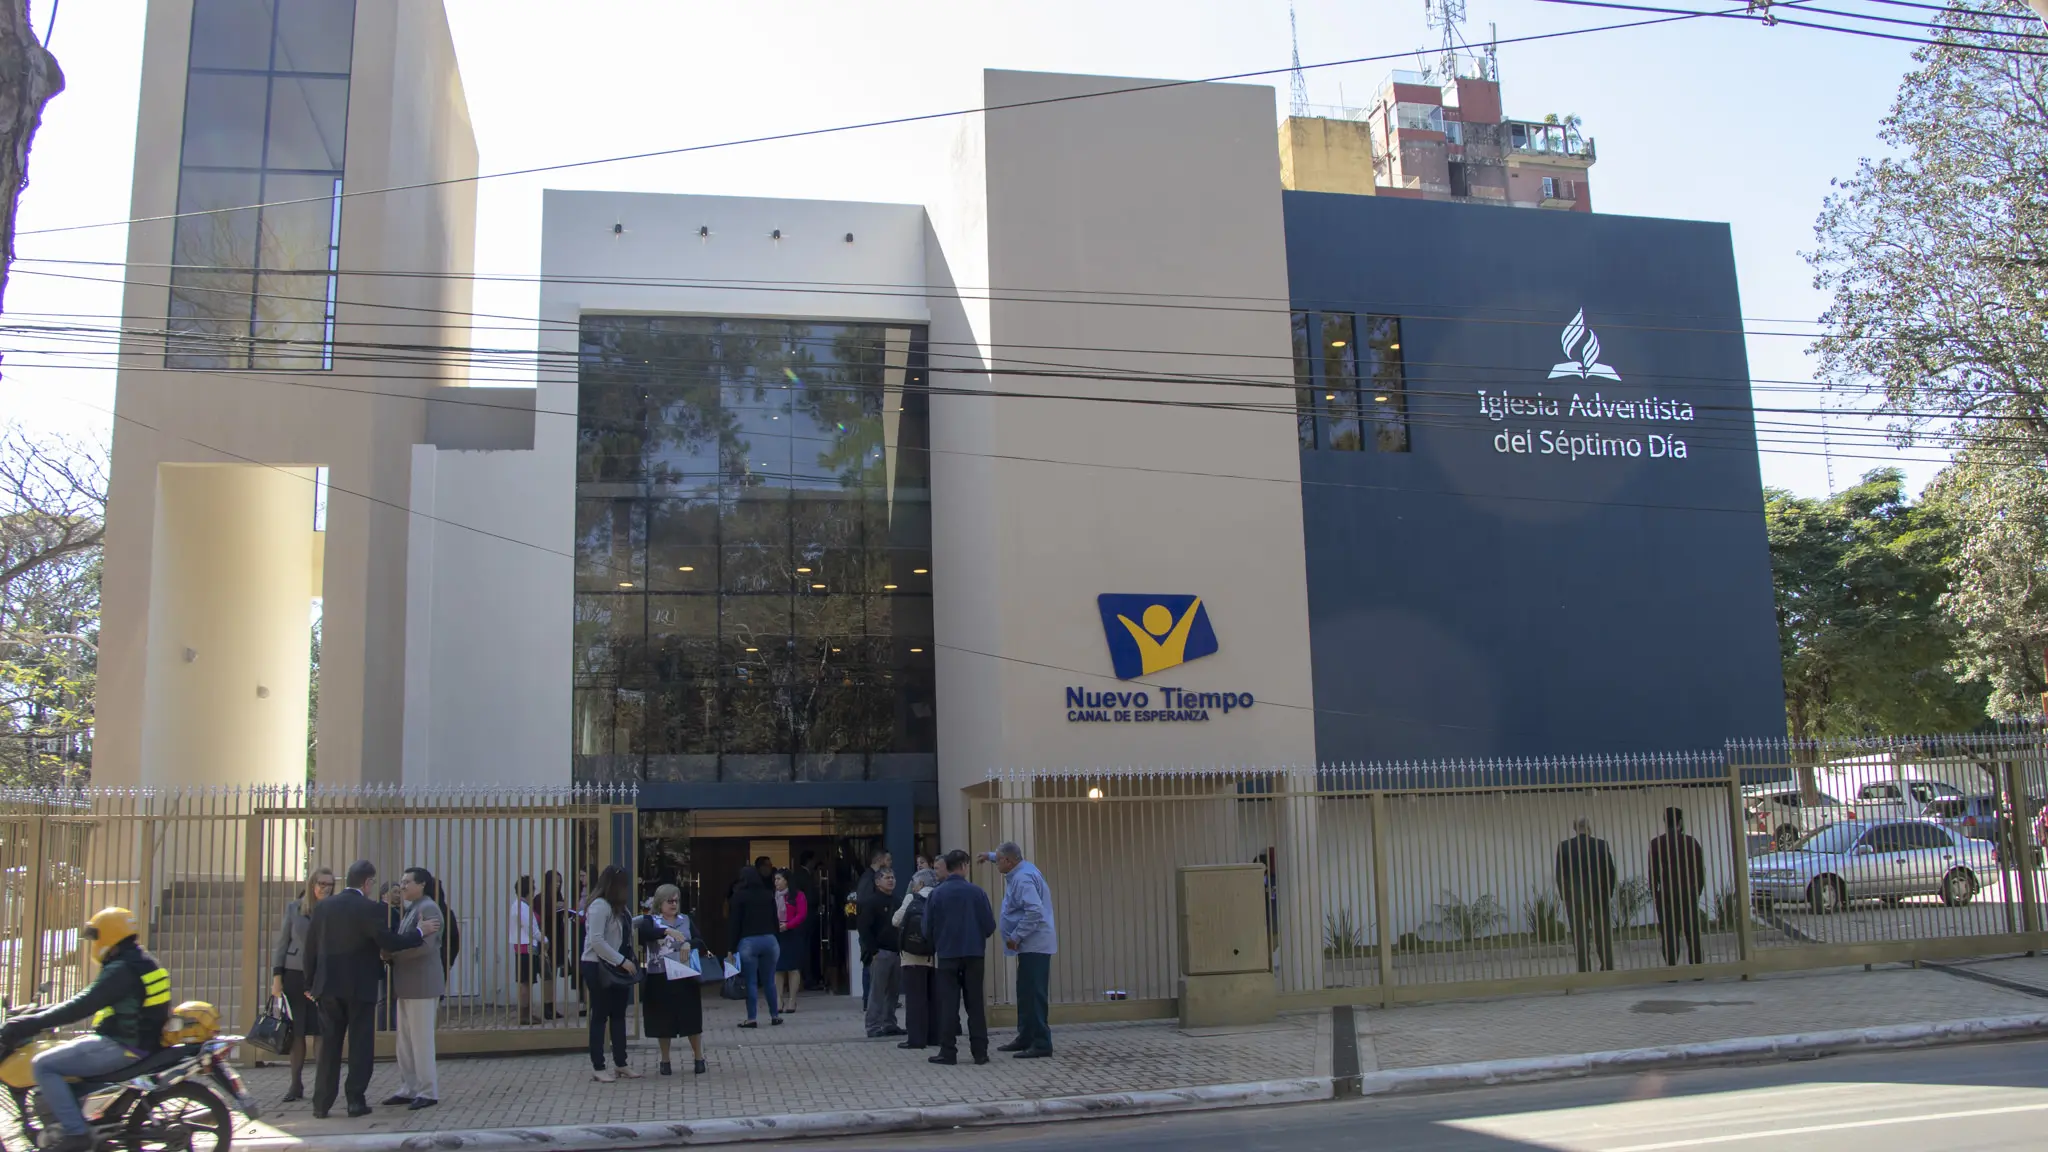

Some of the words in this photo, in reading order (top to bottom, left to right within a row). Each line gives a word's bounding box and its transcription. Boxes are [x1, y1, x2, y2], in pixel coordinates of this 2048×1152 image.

[1477, 390, 1558, 420] Iglesia
[1569, 392, 1694, 420] Adventista
[1494, 428, 1533, 454] del
[1539, 429, 1642, 461] Séptimo
[1648, 433, 1688, 459] Día
[1066, 686, 1149, 709] Nuevo
[1159, 687, 1254, 714] Tiempo
[1067, 710, 1111, 722] CANAL
[1114, 710, 1131, 722] DE
[1134, 710, 1209, 722] ESPERANZA
